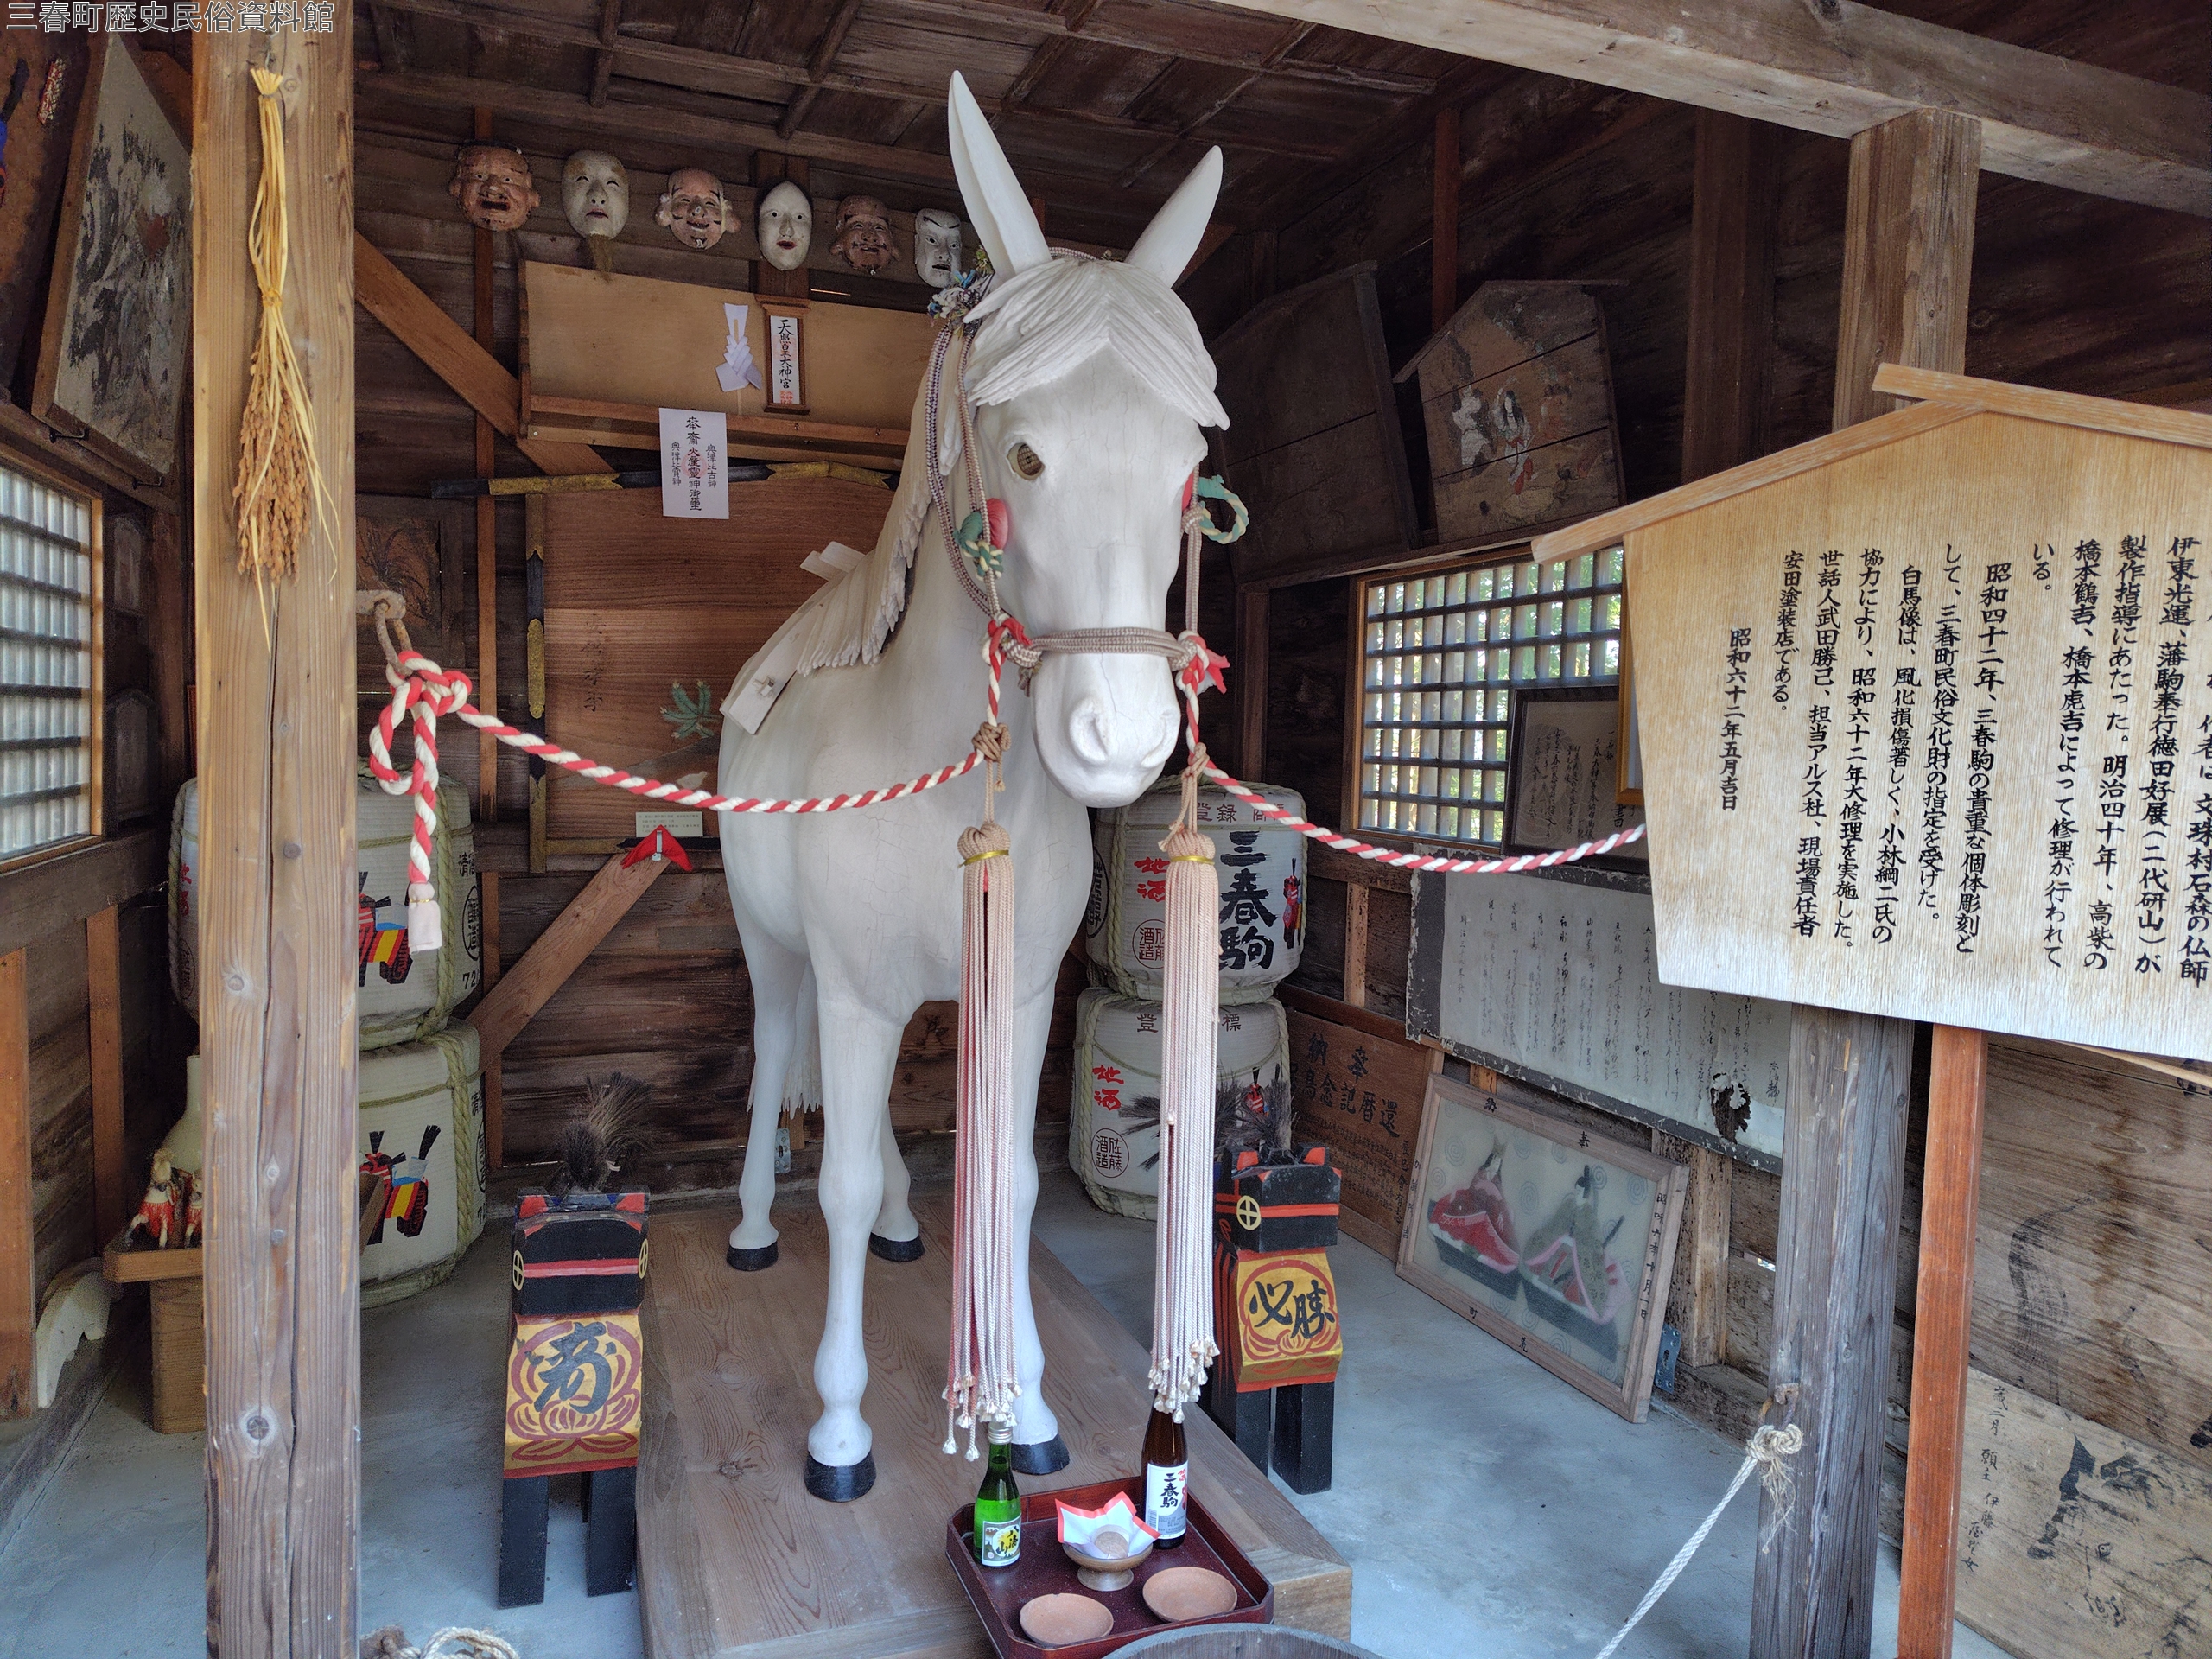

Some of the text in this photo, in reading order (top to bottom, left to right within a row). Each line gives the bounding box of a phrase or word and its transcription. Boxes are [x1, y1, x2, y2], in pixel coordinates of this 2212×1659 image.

[778, 320, 794, 389] 天照皇大神宮
[1770, 550, 1805, 712] 安田塗装店である。
[2031, 543, 2057, 594] いる。
[1719, 627, 1752, 812] 昭和六十二年五月吉日
[1791, 550, 1844, 938] 世話人武田勝己、担当アルス社、現場責任者
[1831, 547, 1885, 949] 協力により、昭和六十二年大修理を実施した。
[1872, 564, 1923, 944] 白馬像は、風化損傷著しく、小林綱二氏の
[1917, 543, 1962, 922] して、三春町民俗文化財の指定を受けた。
[1955, 563, 2012, 953] 昭和四十二年、三春駒の貴重な個体彫刻と
[2043, 539, 2104, 968] 橋本鶴吉、橋本虎吉によって修理が行われて
[2083, 534, 2148, 971] 製作指導にあたった。明治四十年、高柴の
[1218, 830, 1278, 971] 三春駒
[1249, 1279, 1336, 1340] 必勝
[1160, 1472, 1179, 1509] 三春駒
